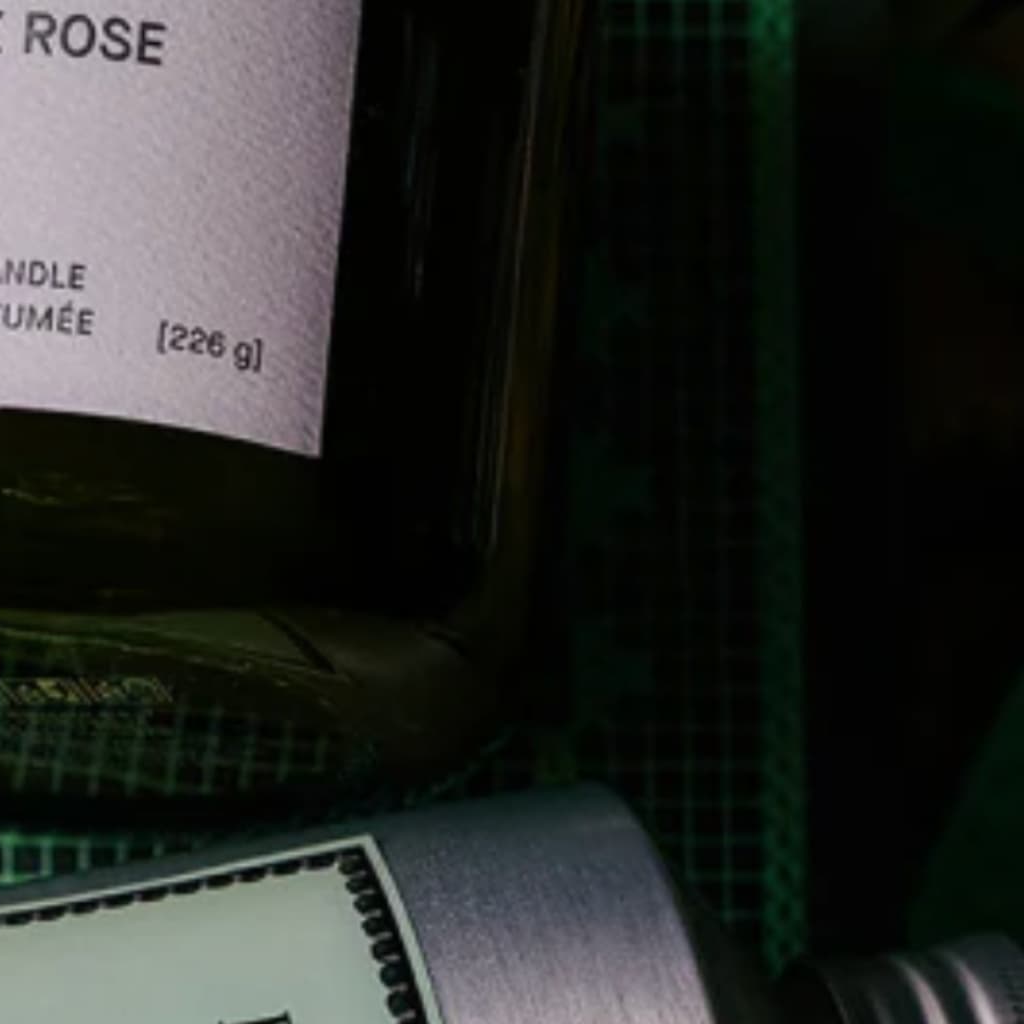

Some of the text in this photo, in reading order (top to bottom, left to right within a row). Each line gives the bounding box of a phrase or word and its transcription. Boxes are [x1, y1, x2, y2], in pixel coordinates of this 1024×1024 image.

[22, 11, 169, 66] ROSE
[156, 319, 265, 374] [226 g]
